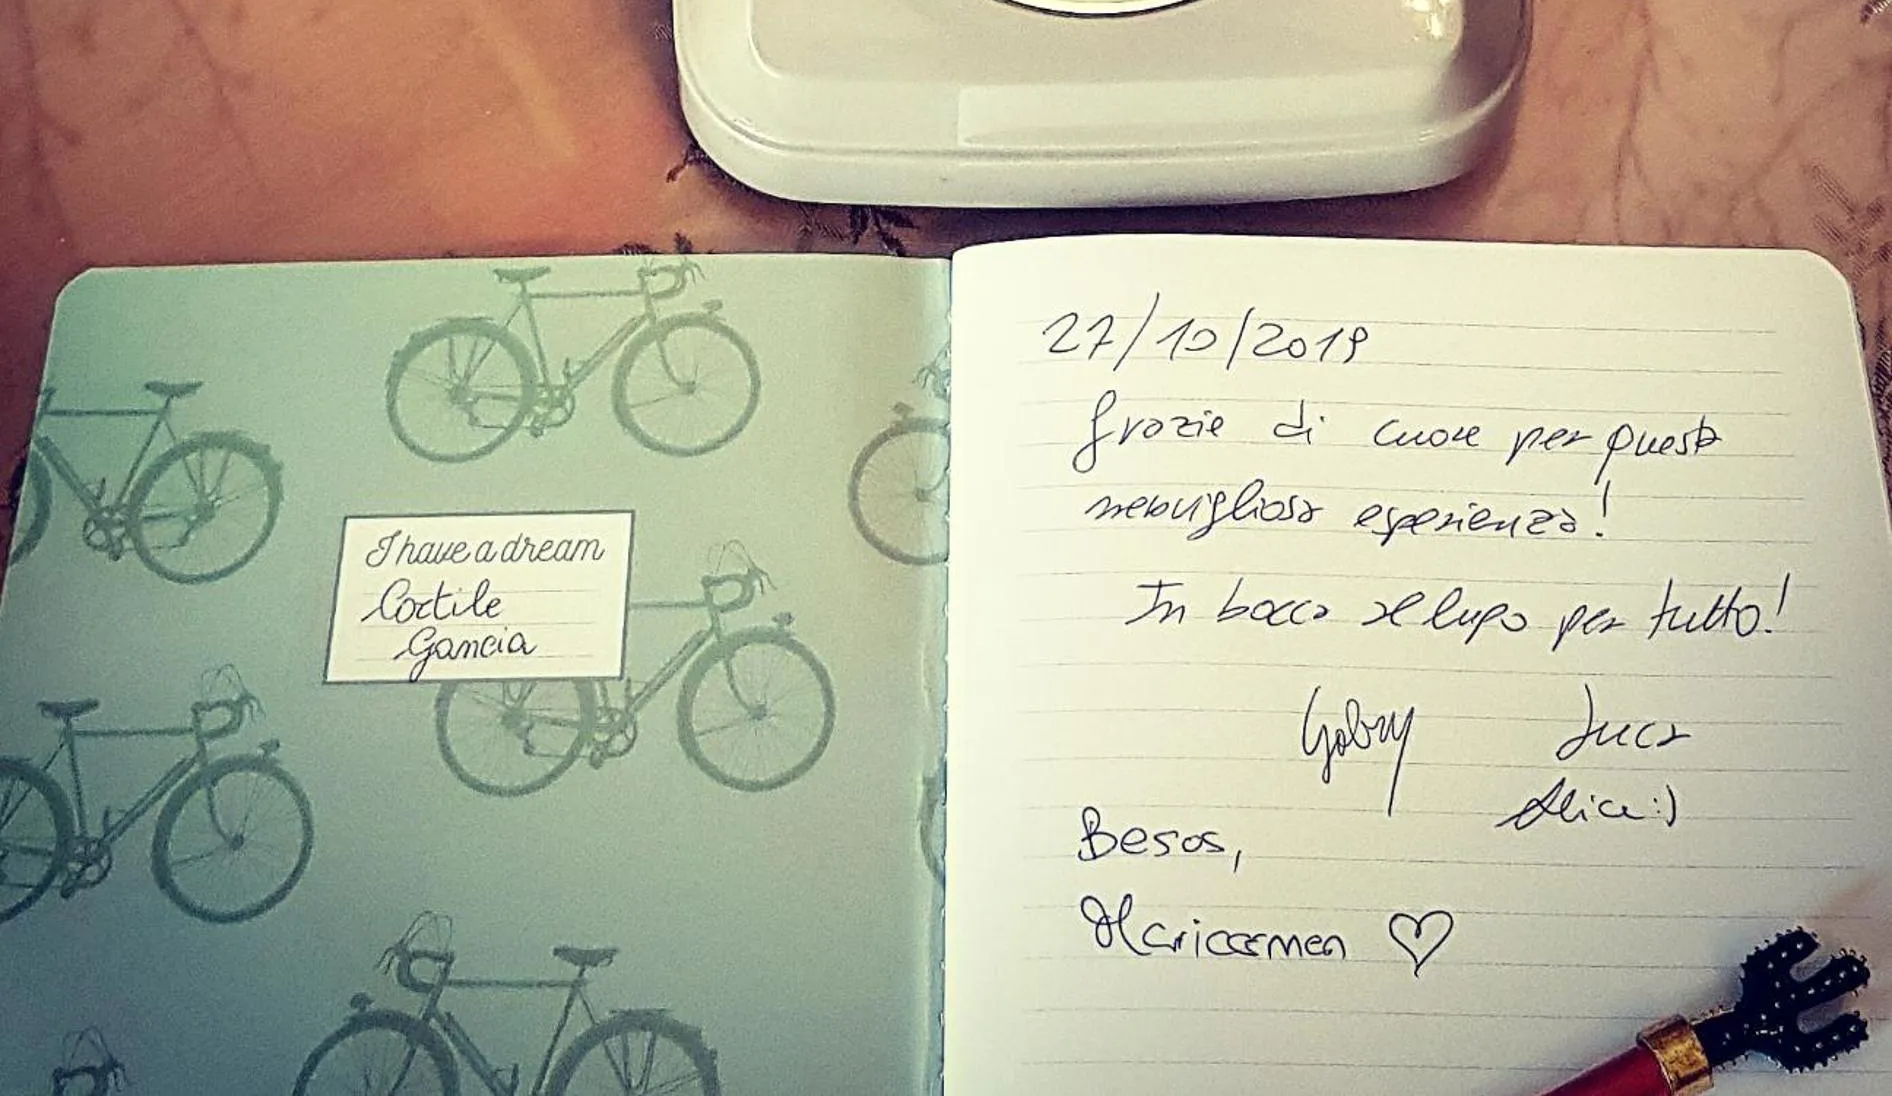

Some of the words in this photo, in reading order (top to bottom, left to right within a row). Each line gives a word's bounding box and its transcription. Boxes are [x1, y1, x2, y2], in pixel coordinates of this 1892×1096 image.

[1273, 400, 1325, 444] di
[1505, 425, 1593, 466] per
[395, 535, 471, 565] have
[475, 544, 499, 562] a
[501, 533, 606, 562] dream
[361, 578, 503, 624] Cortile
[1125, 580, 1185, 625] In
[1217, 577, 1330, 626] bocca
[1422, 587, 1527, 645] lupo
[1551, 604, 1626, 652] per
[394, 626, 538, 683] Gancia
[1078, 807, 1241, 873] Besos,
